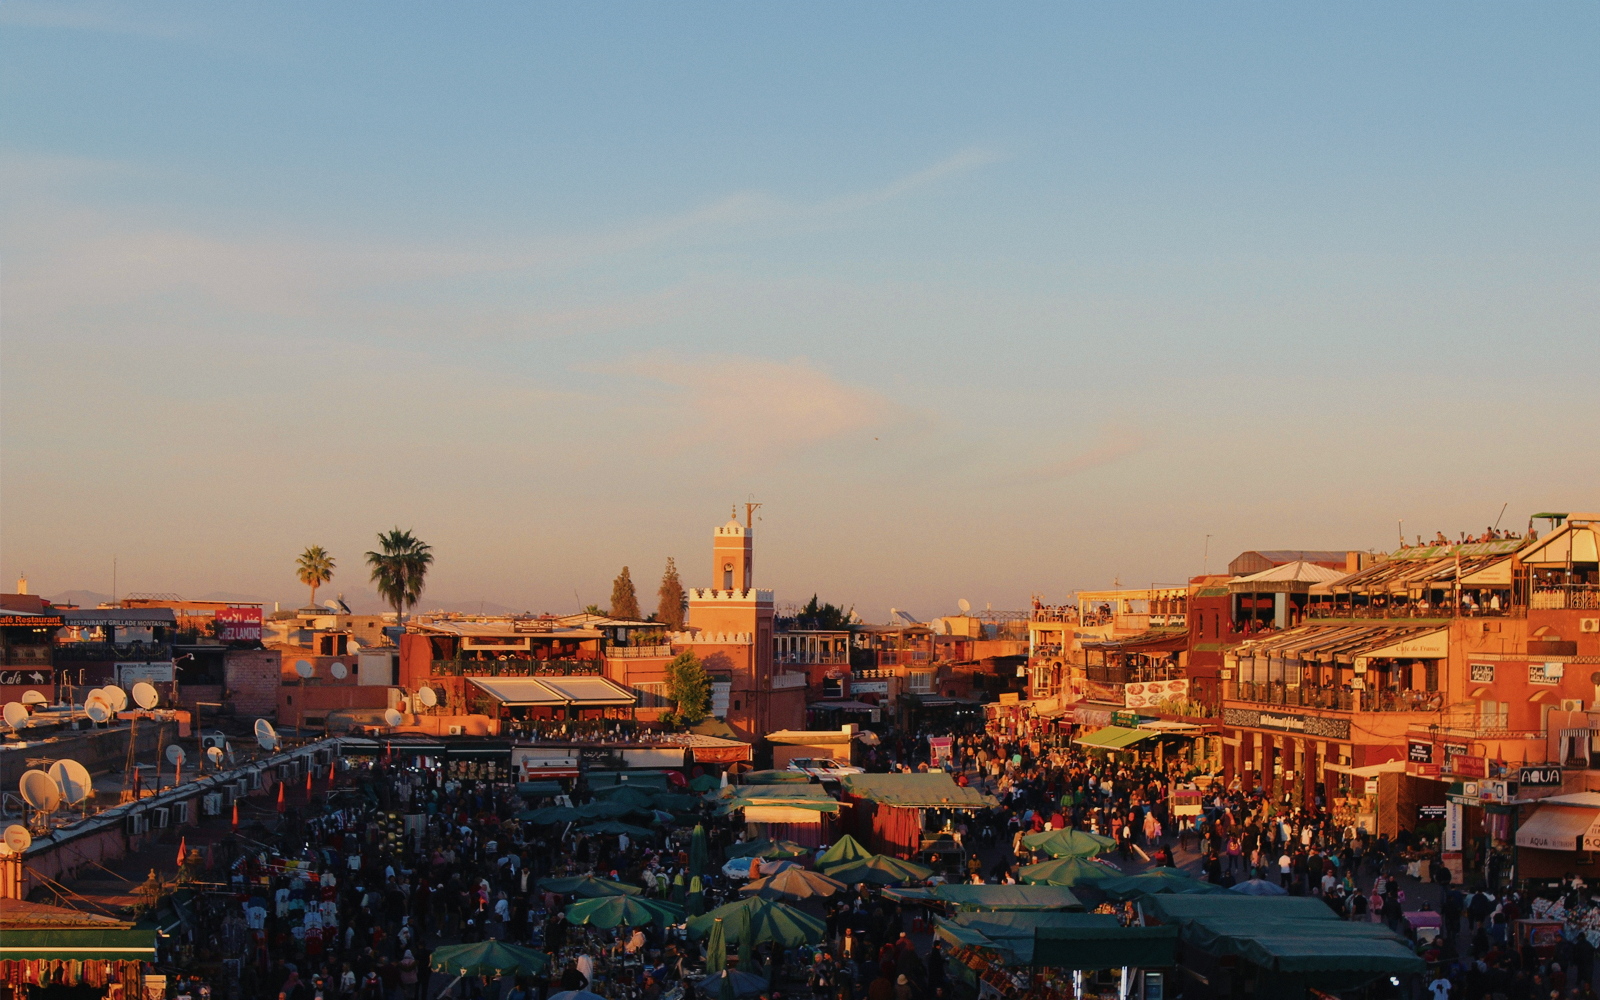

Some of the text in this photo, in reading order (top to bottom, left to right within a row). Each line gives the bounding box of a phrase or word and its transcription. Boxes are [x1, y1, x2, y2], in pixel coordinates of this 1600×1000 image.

[1460, 540, 1521, 555] FRANCE
[15, 615, 61, 623] Restaurant
[235, 627, 261, 640] LAMINE
[0, 670, 22, 685] Café
[1521, 769, 1560, 783] AQUA
[1530, 837, 1548, 846] AQUA
